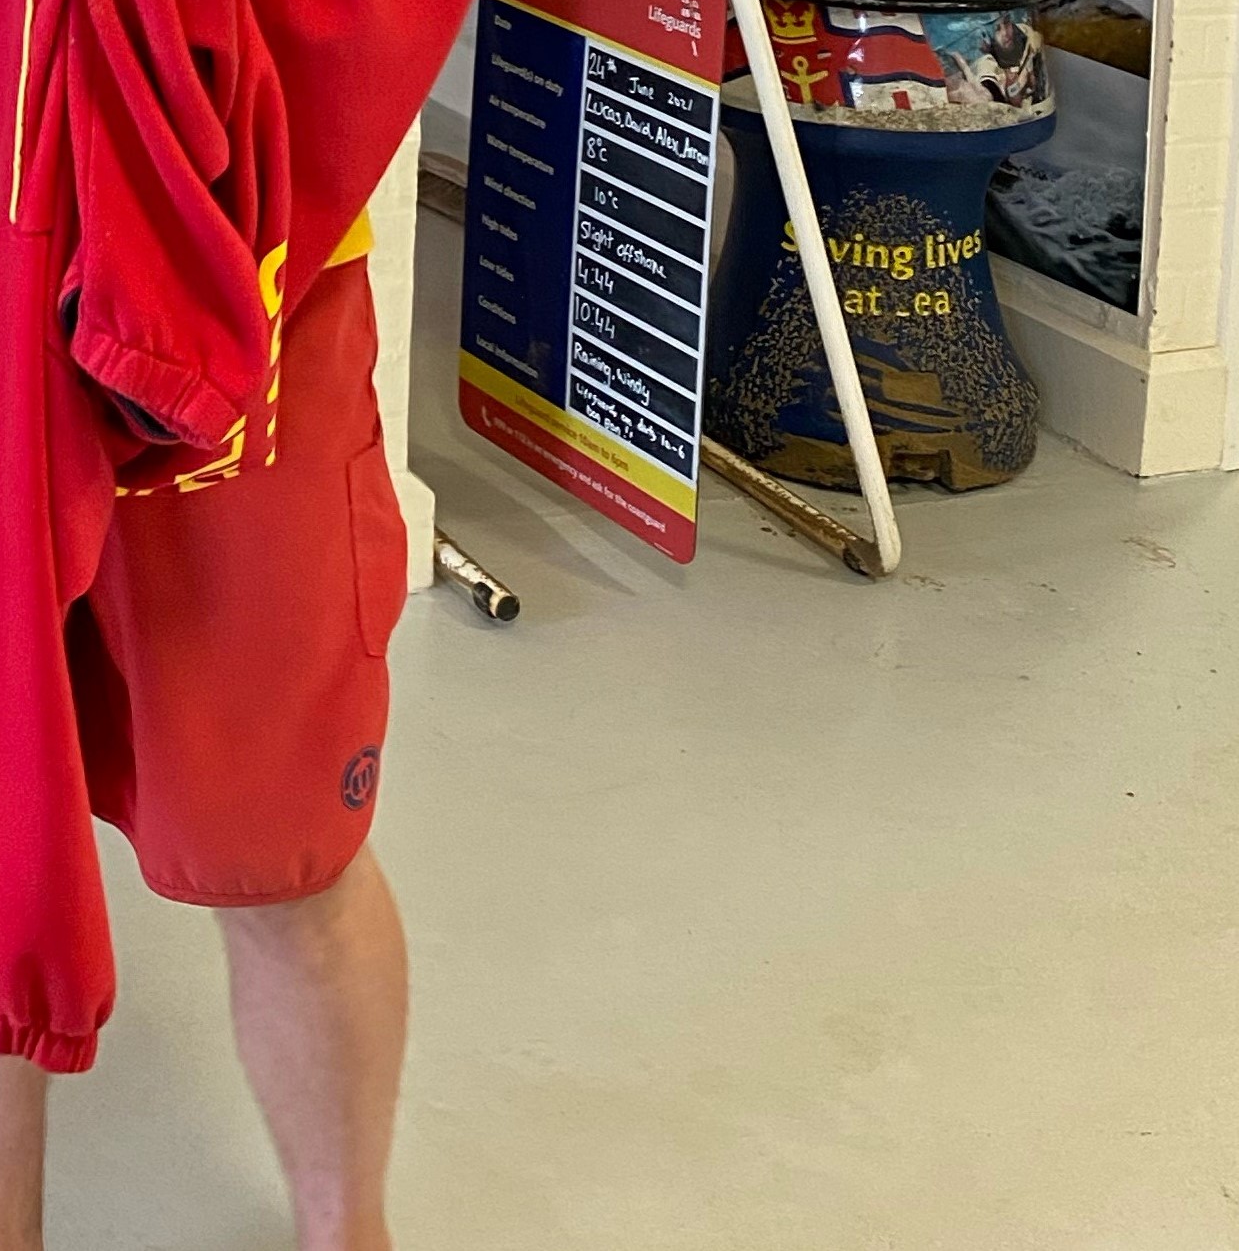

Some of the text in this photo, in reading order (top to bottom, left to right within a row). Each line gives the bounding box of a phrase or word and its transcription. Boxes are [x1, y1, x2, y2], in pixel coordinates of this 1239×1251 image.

[648, 4, 702, 39] Lifeguards
[628, 77, 654, 100] June
[667, 92, 693, 111] 2021
[781, 221, 982, 281] Sving lives
[578, 258, 614, 294] 4:44
[575, 296, 615, 339] 10:44
[844, 285, 950, 317] at ea
